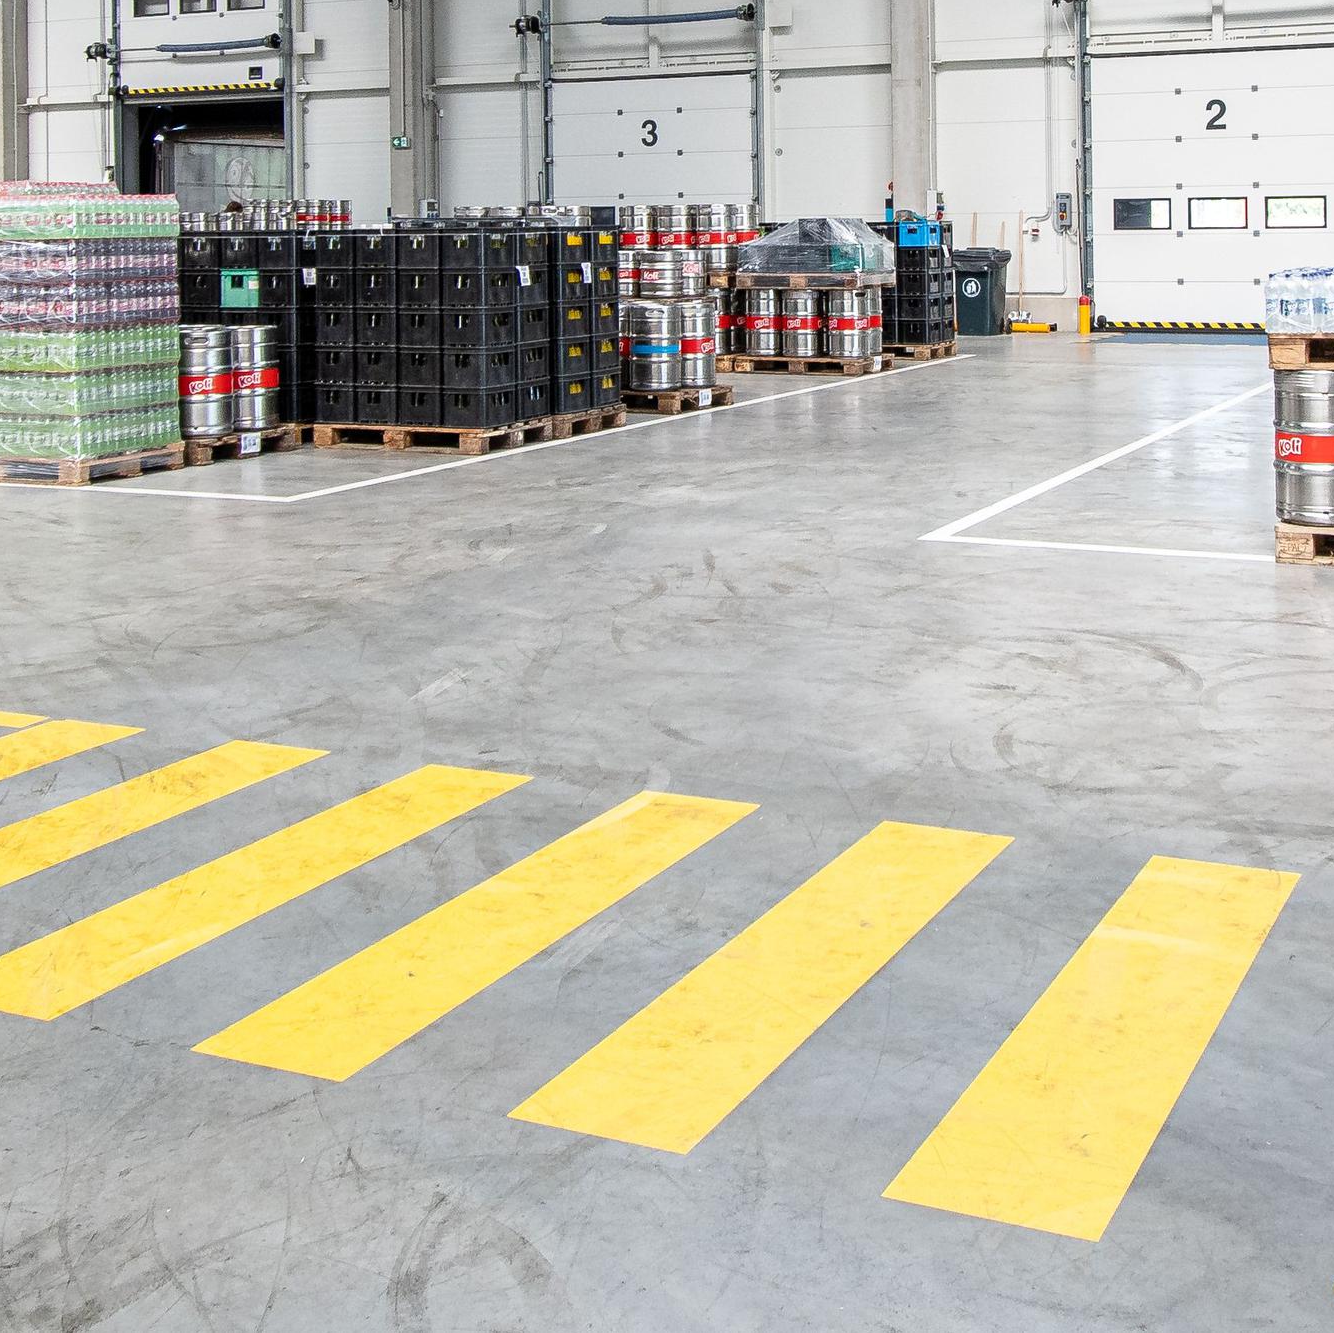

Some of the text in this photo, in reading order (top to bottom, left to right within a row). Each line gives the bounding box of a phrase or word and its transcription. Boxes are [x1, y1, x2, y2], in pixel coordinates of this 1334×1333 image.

[1205, 99, 1227, 130] 2
[641, 119, 658, 147] 3
[189, 378, 213, 394] Koli
[238, 372, 261, 387] Koli
[1279, 437, 1302, 456] Koli
